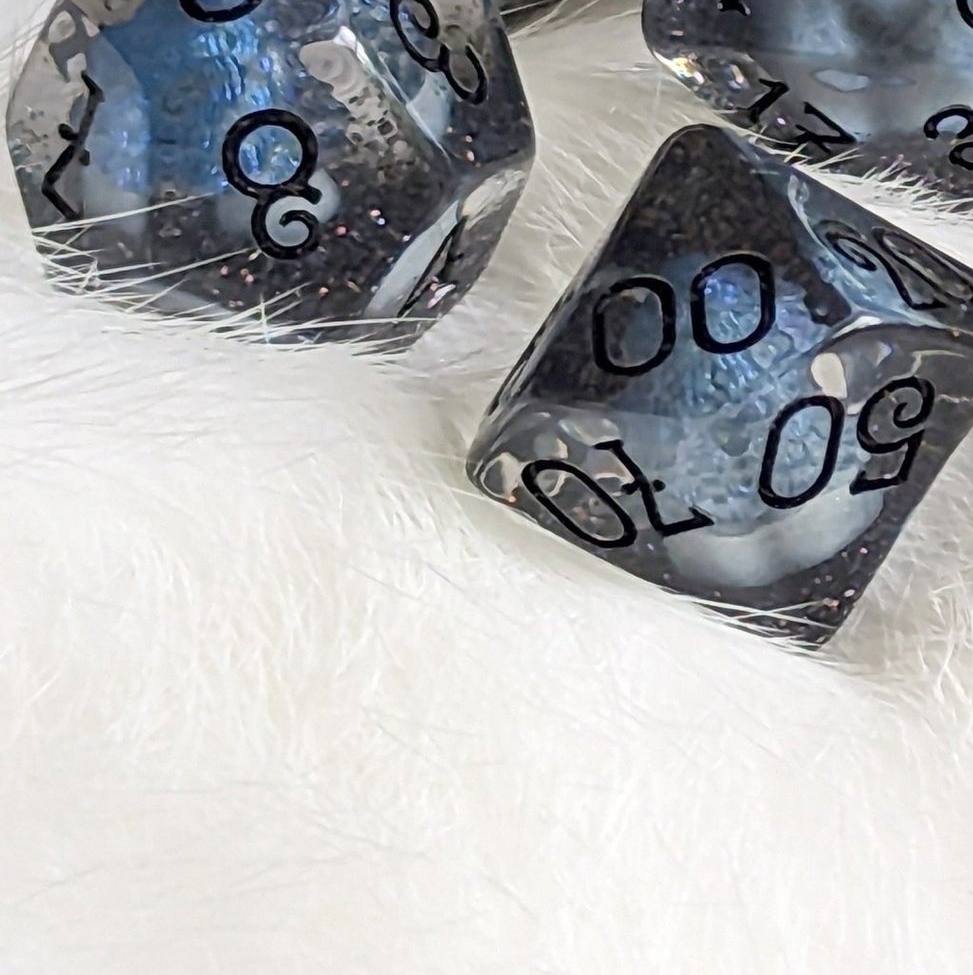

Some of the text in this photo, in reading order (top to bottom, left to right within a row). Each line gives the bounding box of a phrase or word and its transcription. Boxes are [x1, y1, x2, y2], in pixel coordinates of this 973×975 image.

[222, 108, 324, 260] 8
[592, 250, 776, 376] 00
[520, 438, 716, 550] 70
[757, 376, 937, 510] 50
